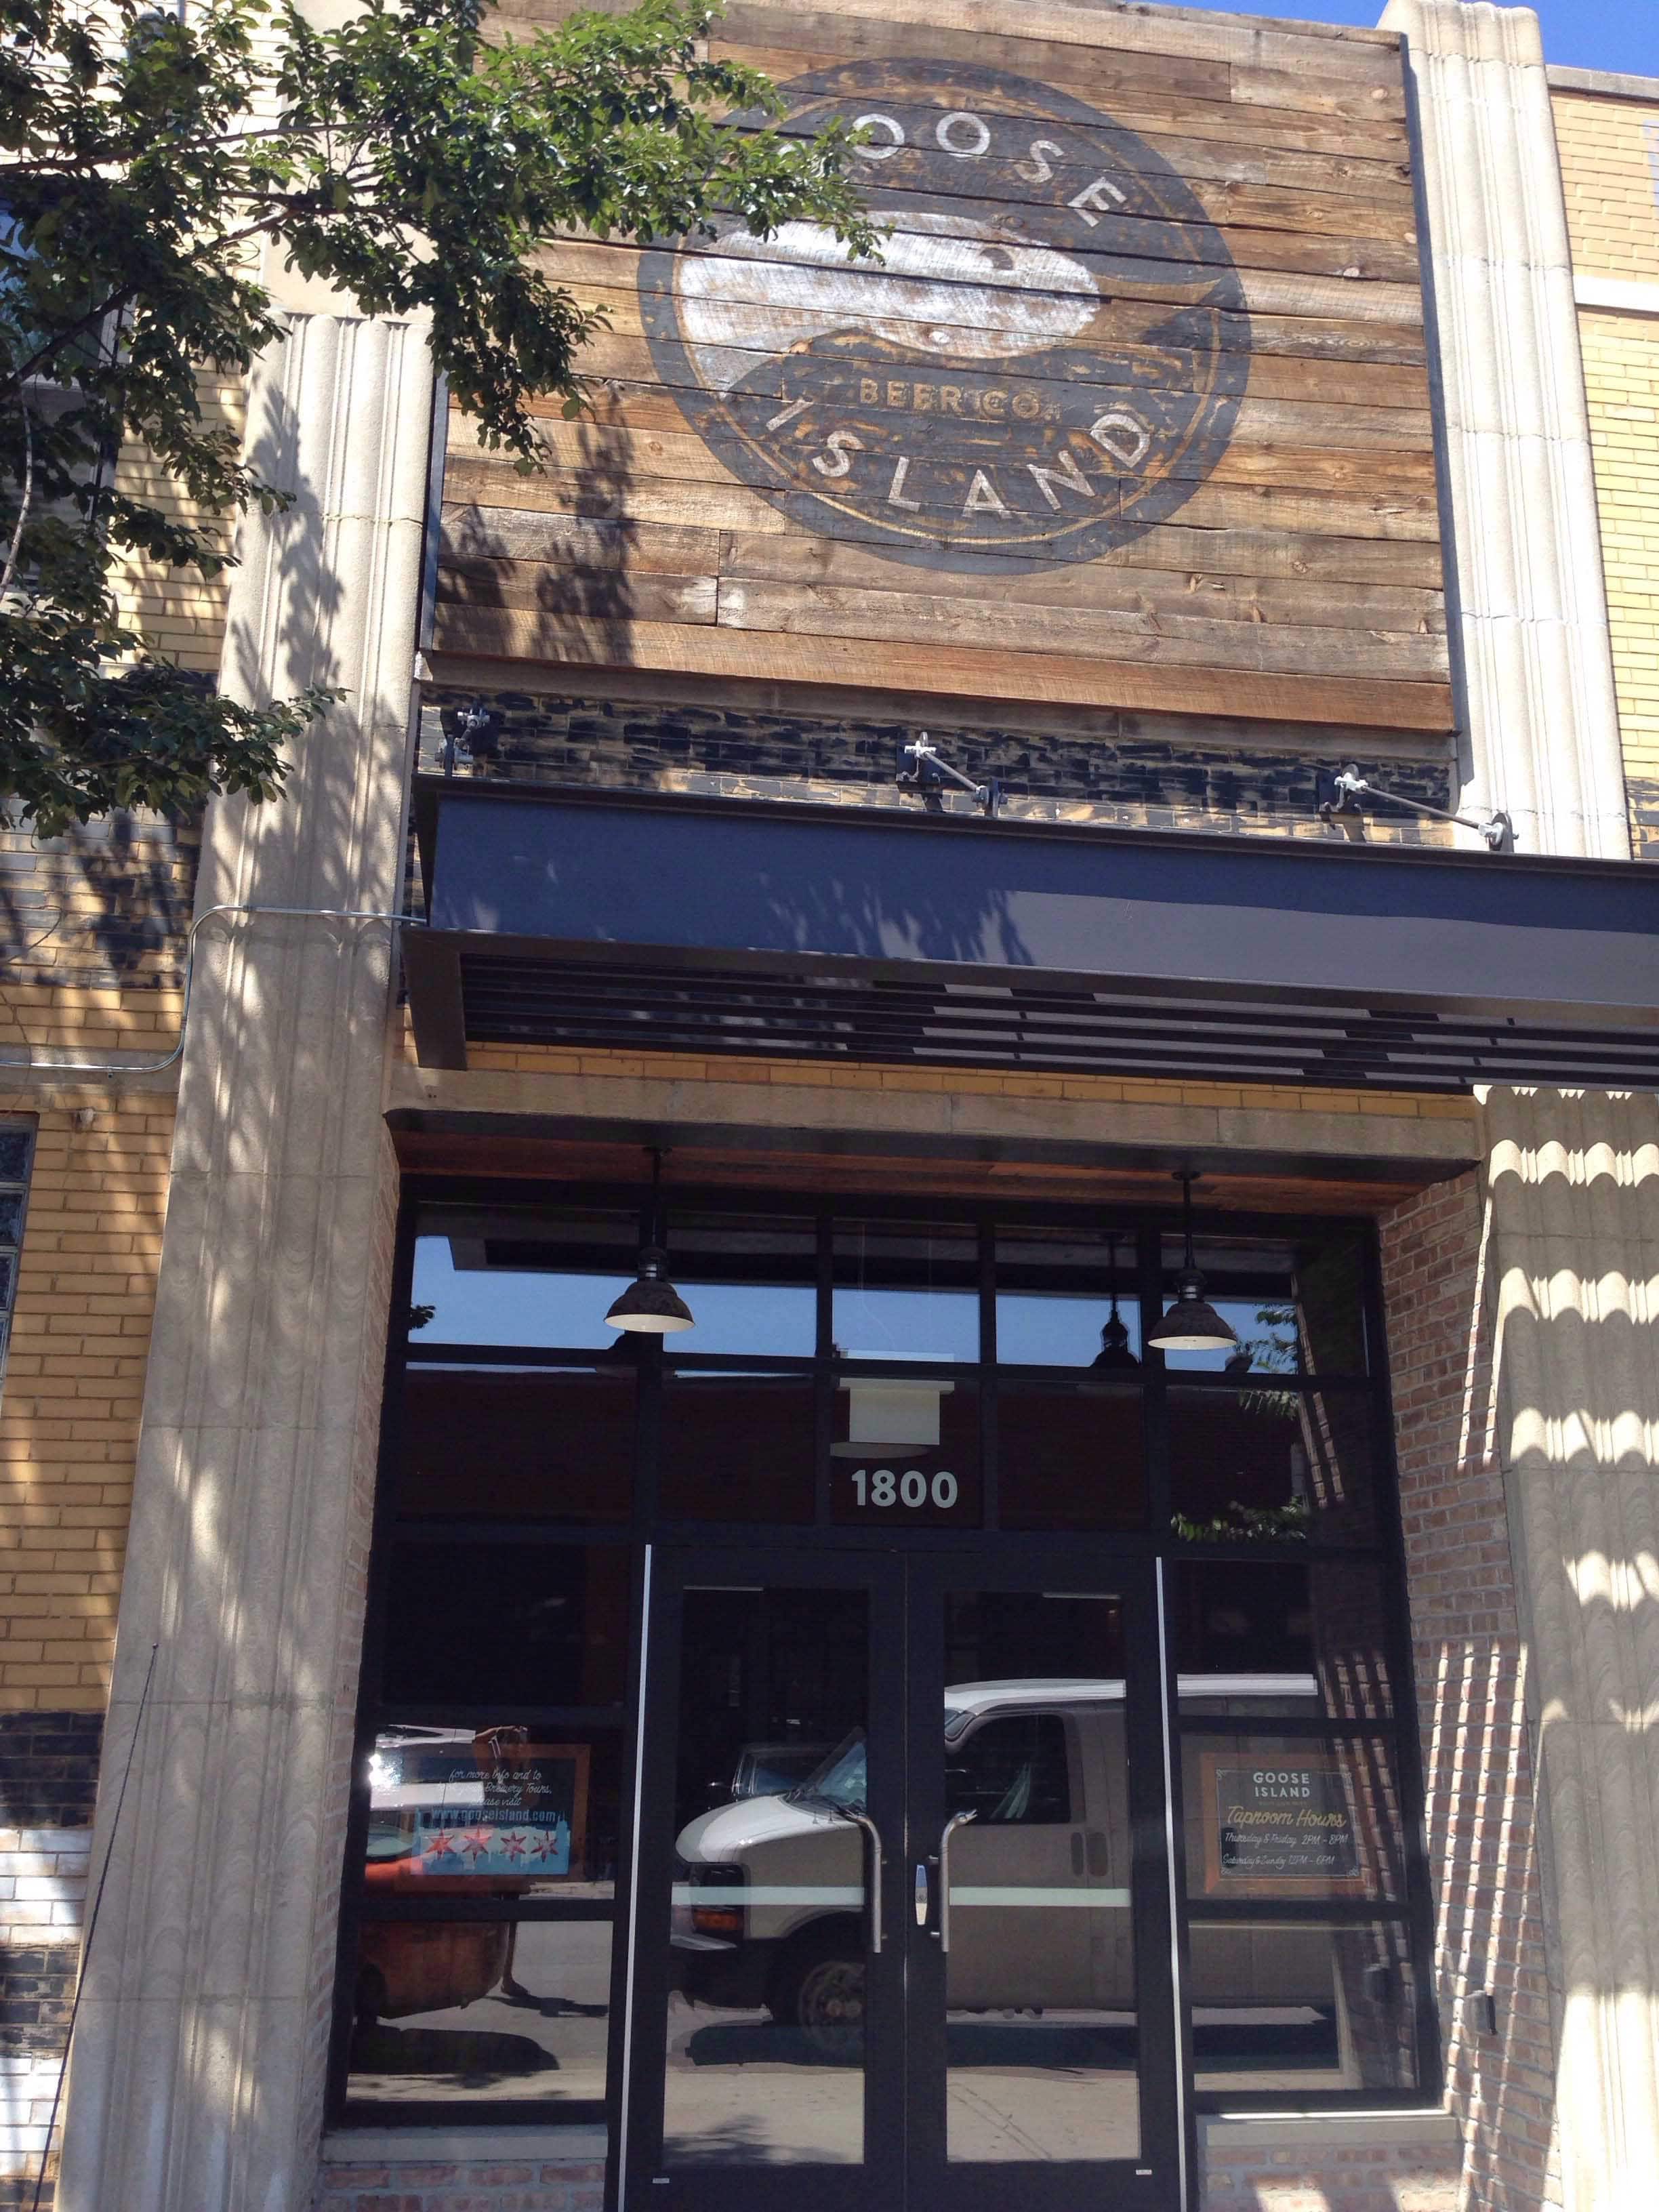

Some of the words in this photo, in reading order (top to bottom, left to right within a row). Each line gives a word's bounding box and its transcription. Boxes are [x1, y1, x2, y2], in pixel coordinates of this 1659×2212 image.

[777, 111, 1126, 227] OOSE
[859, 377, 965, 413] BEER
[766, 396, 1151, 520] ISLAND
[851, 1469, 958, 1509] 1800
[449, 1769, 465, 1782] for
[466, 1771, 489, 1780] more
[513, 1769, 532, 1780] and
[533, 1769, 542, 1780] to
[1253, 1772, 1310, 1784] GOOSE
[501, 1797, 522, 1806] visit
[1255, 1787, 1310, 1797] ISLAND
[1227, 1805, 1294, 1828] Taproom
[1296, 1809, 1347, 1828] Hours
[1225, 1832, 1262, 1849] Thursday
[1271, 1833, 1297, 1848] Friday
[1301, 1835, 1320, 1845] 2PM
[1329, 1834, 1349, 1845] 8PM
